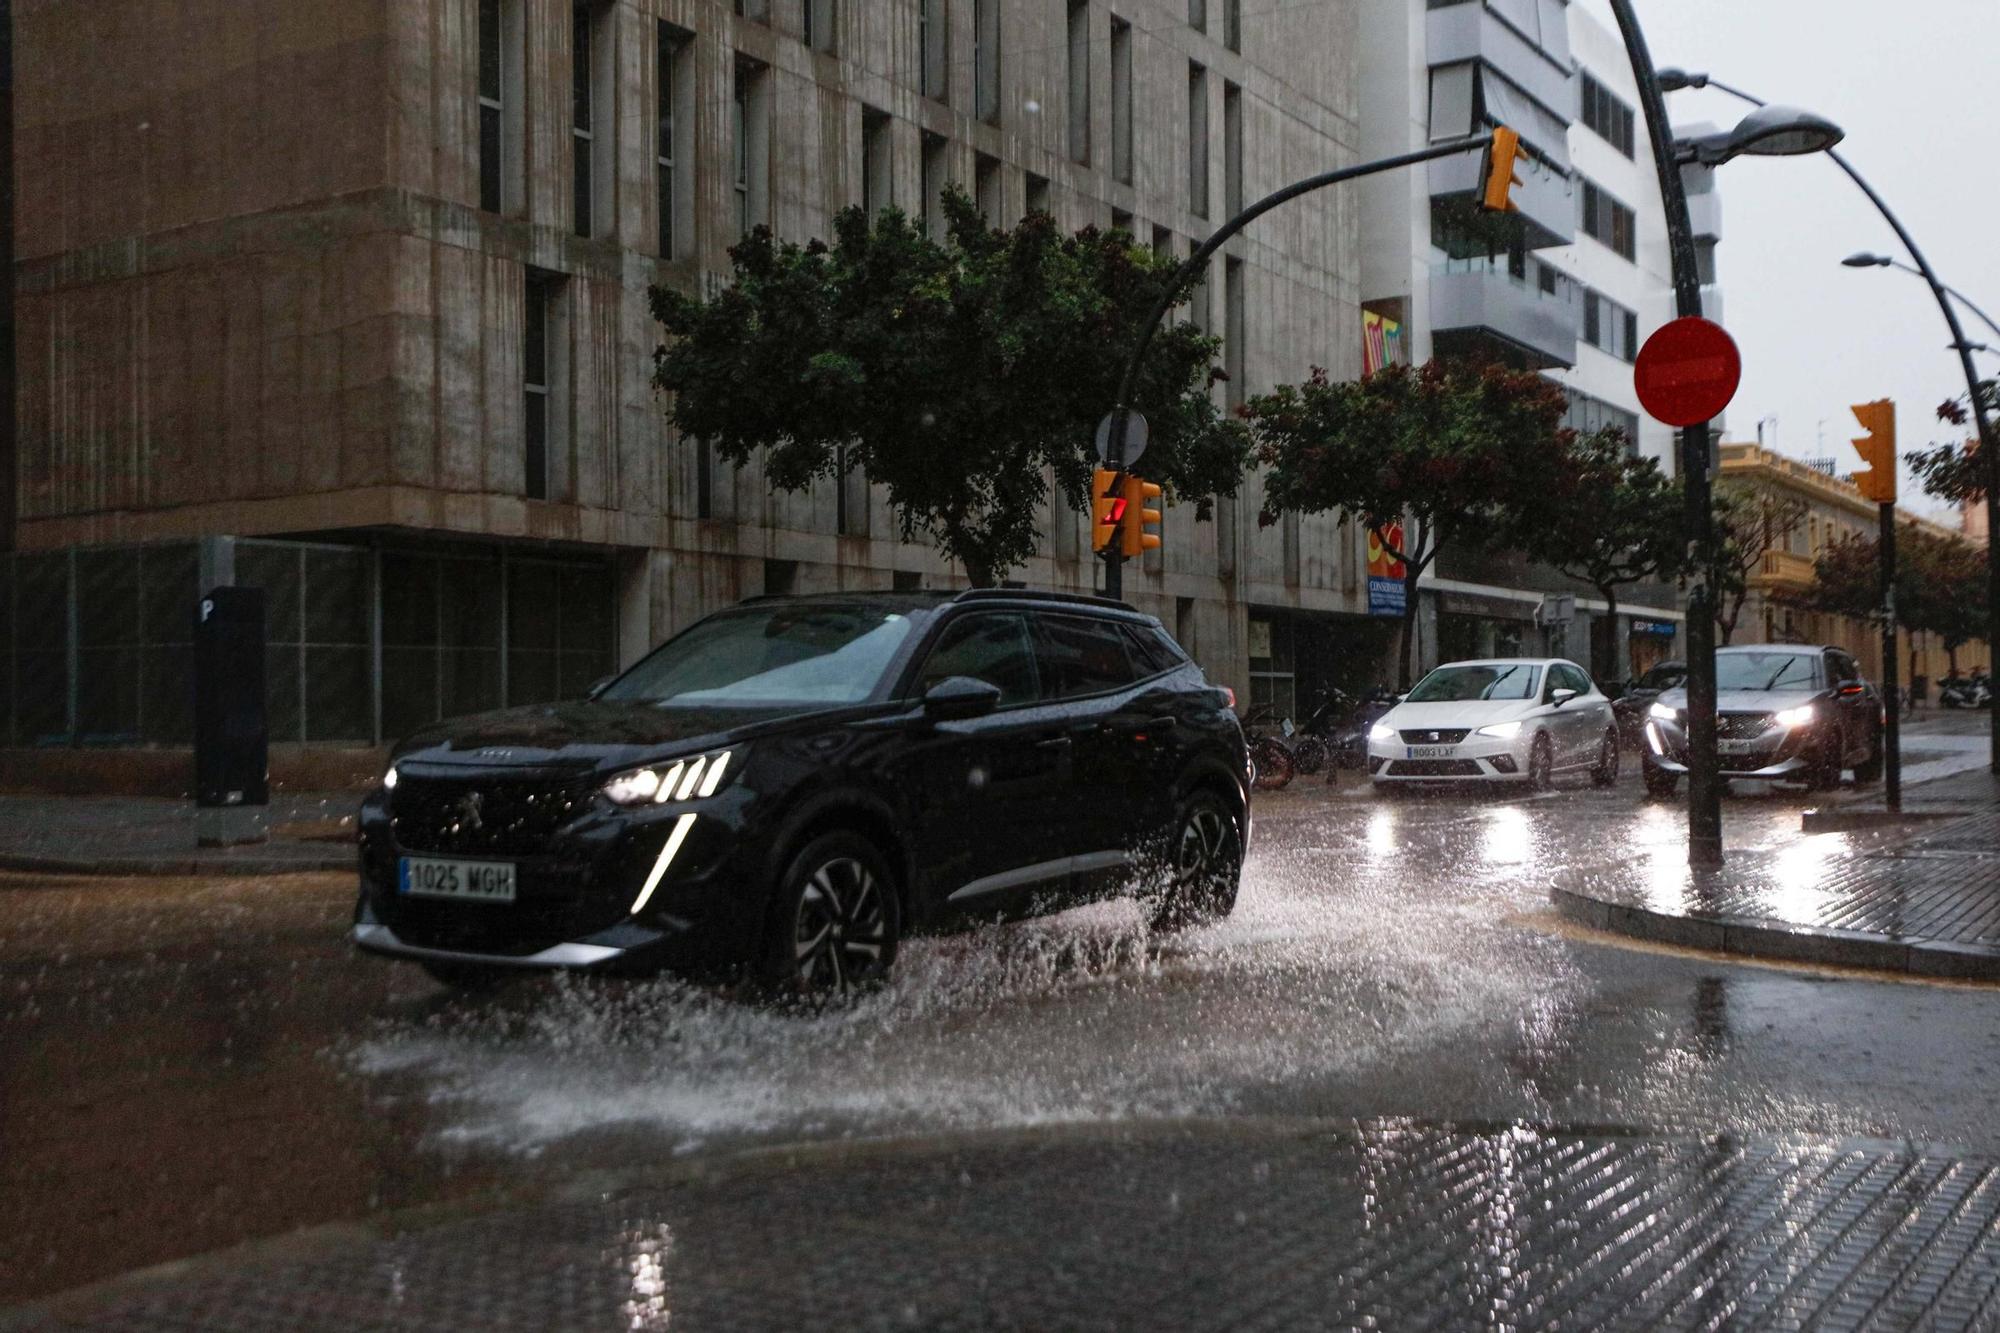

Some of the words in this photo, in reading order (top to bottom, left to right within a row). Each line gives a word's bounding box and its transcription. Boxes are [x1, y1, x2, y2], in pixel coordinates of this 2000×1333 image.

[200, 599, 214, 623] P
[414, 863, 460, 892] 1025
[469, 866, 511, 896] MGH
